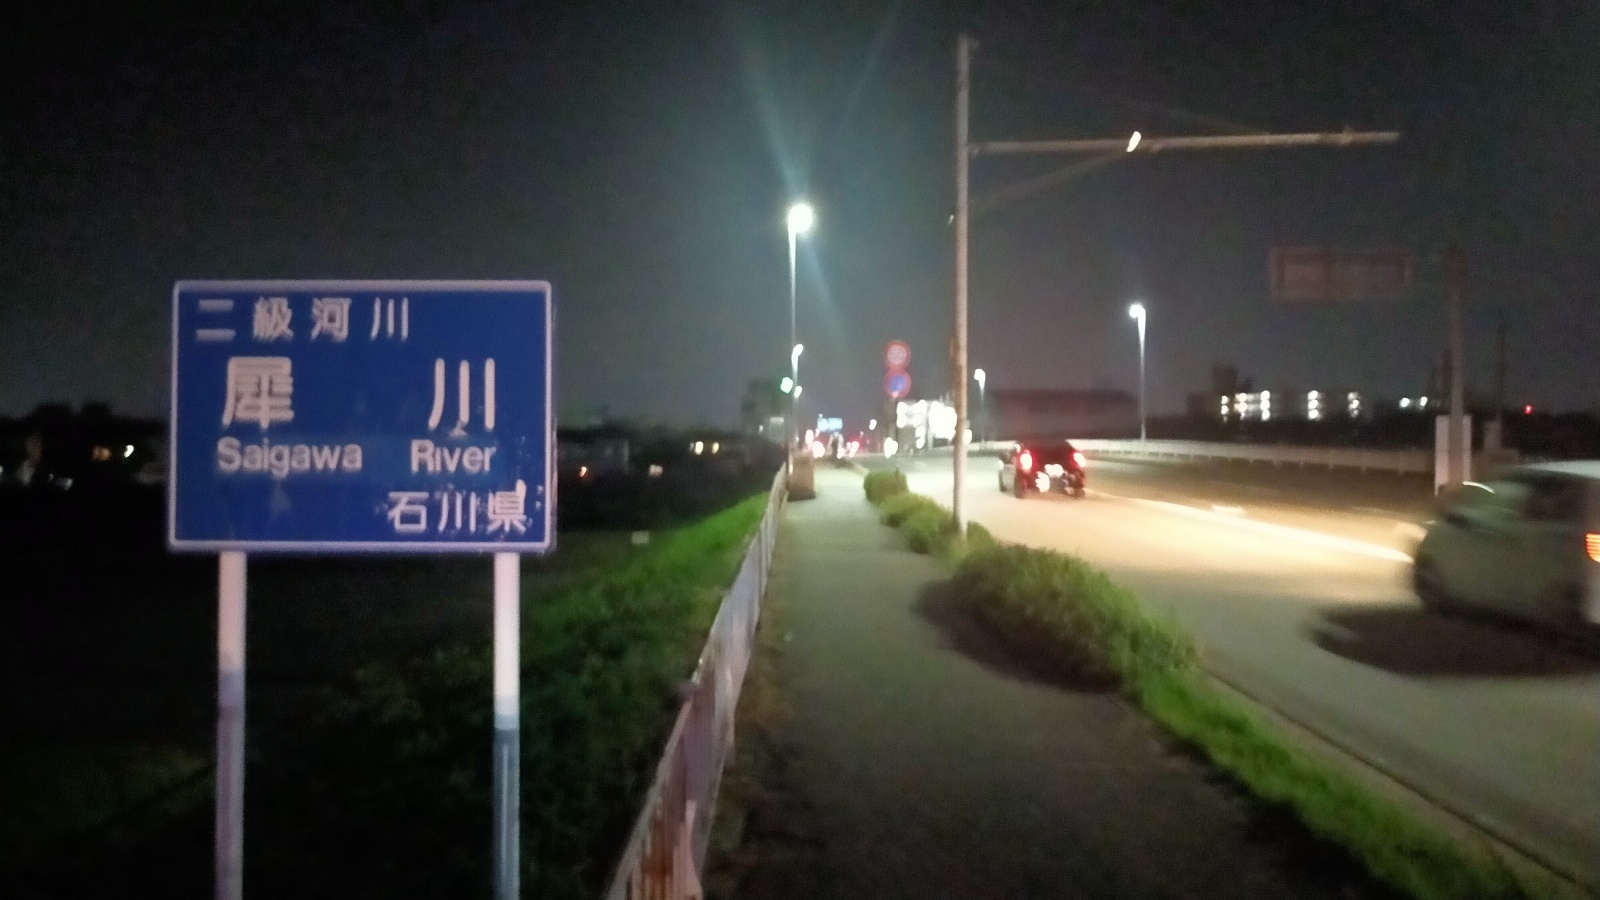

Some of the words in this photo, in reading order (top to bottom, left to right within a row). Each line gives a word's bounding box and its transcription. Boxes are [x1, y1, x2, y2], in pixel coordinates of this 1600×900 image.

[197, 297, 408, 341] 二級河川
[217, 436, 362, 478] Saigawa
[411, 439, 496, 474] River
[388, 490, 527, 534] 石川県
